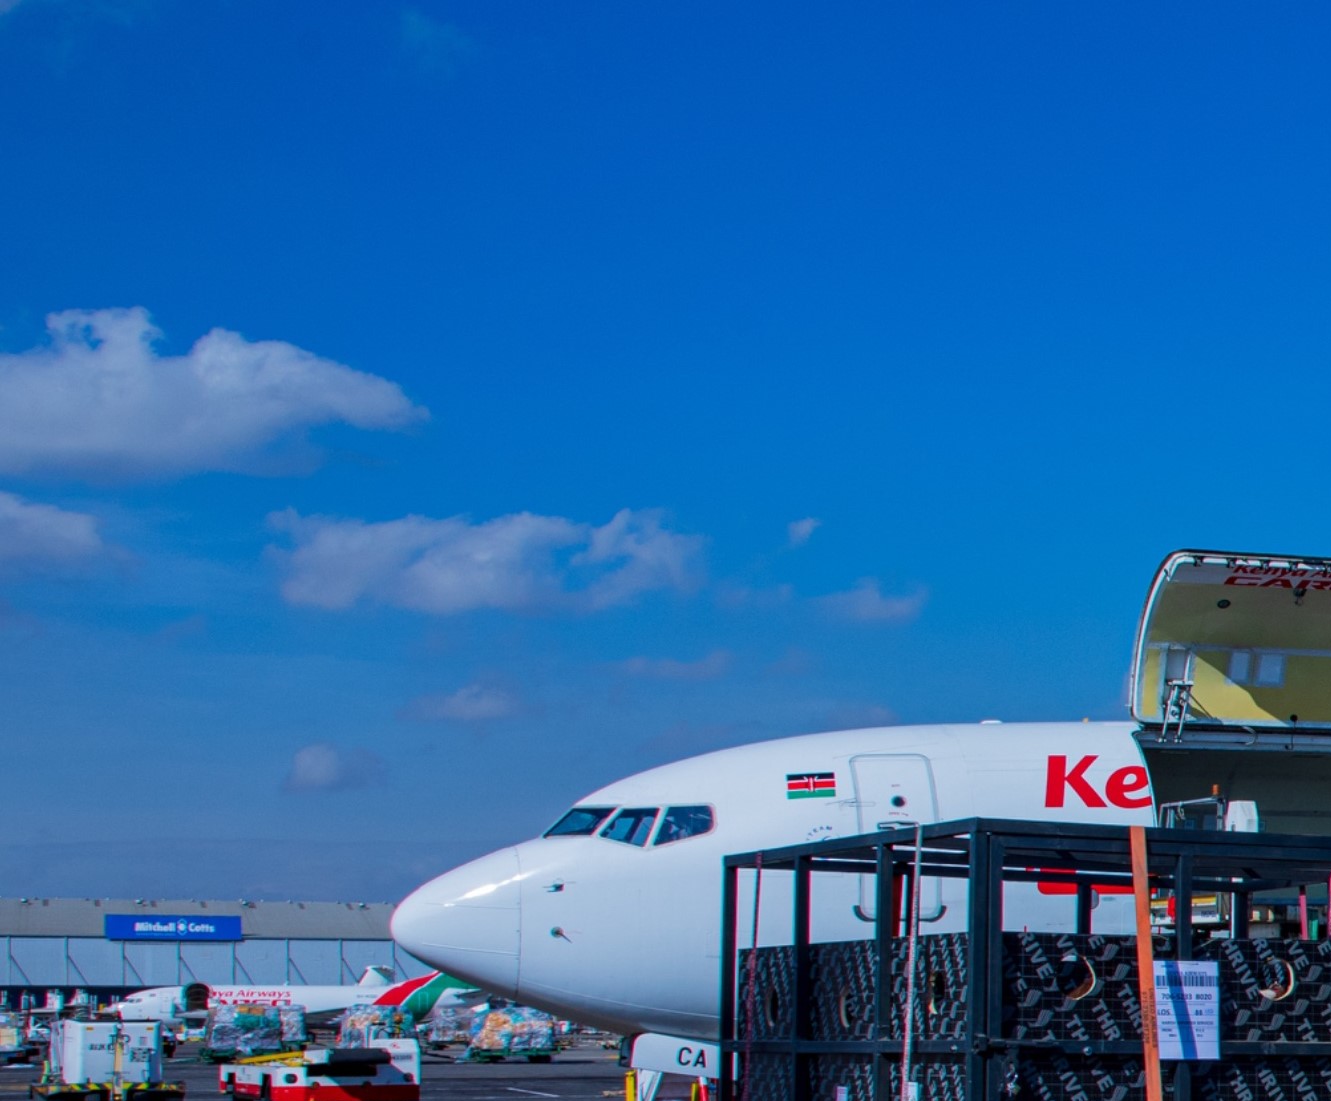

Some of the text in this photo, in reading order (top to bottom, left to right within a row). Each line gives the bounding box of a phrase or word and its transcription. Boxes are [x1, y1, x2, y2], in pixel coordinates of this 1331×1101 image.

[134, 921, 215, 933] Mitchell Cotts
[1018, 933, 1053, 980] RIVE
[1221, 940, 1261, 1000] HRIVE
[1091, 998, 1122, 1042] THR
[678, 1046, 707, 1068] CA
